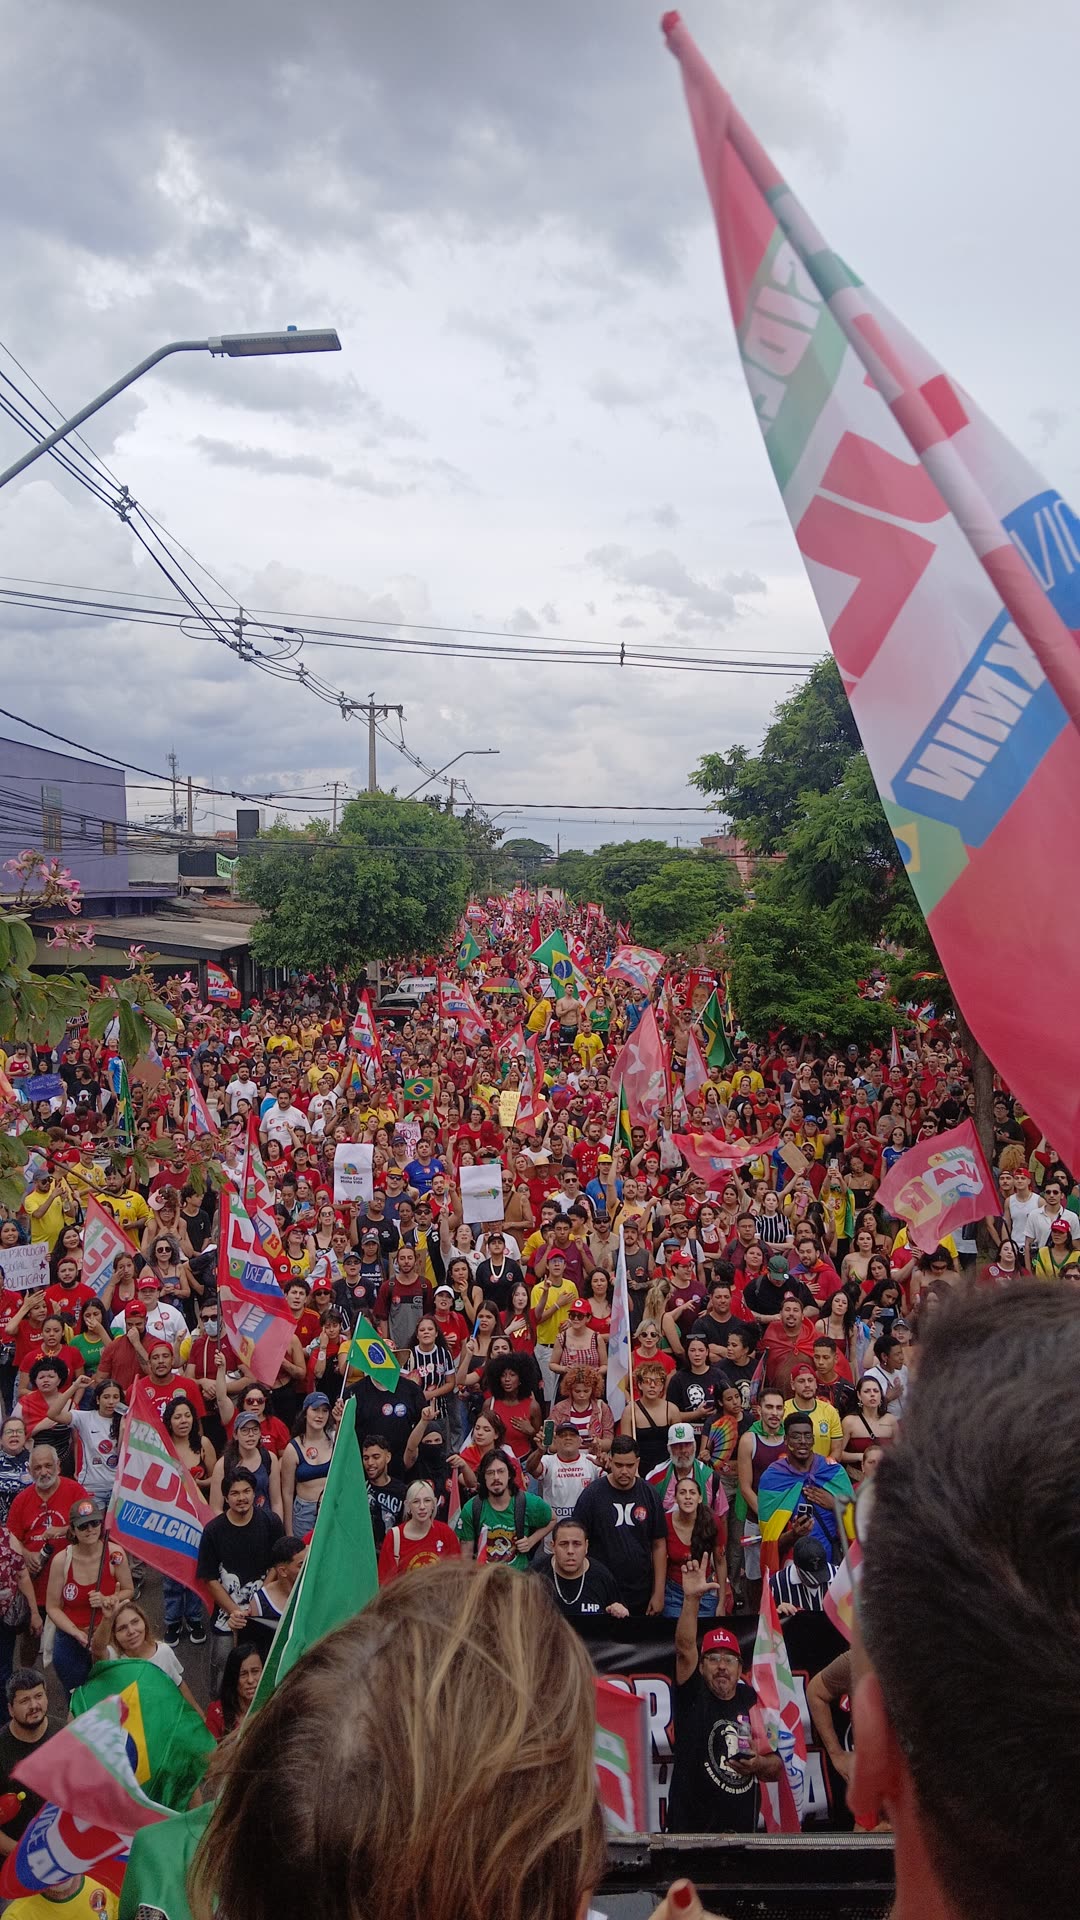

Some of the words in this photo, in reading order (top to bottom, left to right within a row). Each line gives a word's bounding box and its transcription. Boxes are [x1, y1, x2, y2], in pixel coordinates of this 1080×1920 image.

[442, 990, 464, 1002] LU
[267, 1233, 280, 1250] 13
[9, 1245, 46, 1258] PSICOLOGIA
[4, 1261, 27, 1273] SOCIAL
[121, 1503, 149, 1526] VICE
[581, 1603, 600, 1612] LHP
[713, 1633, 731, 1642] LULA
[607, 1679, 673, 1756] R
[706, 1767, 721, 1786] BRASIL
